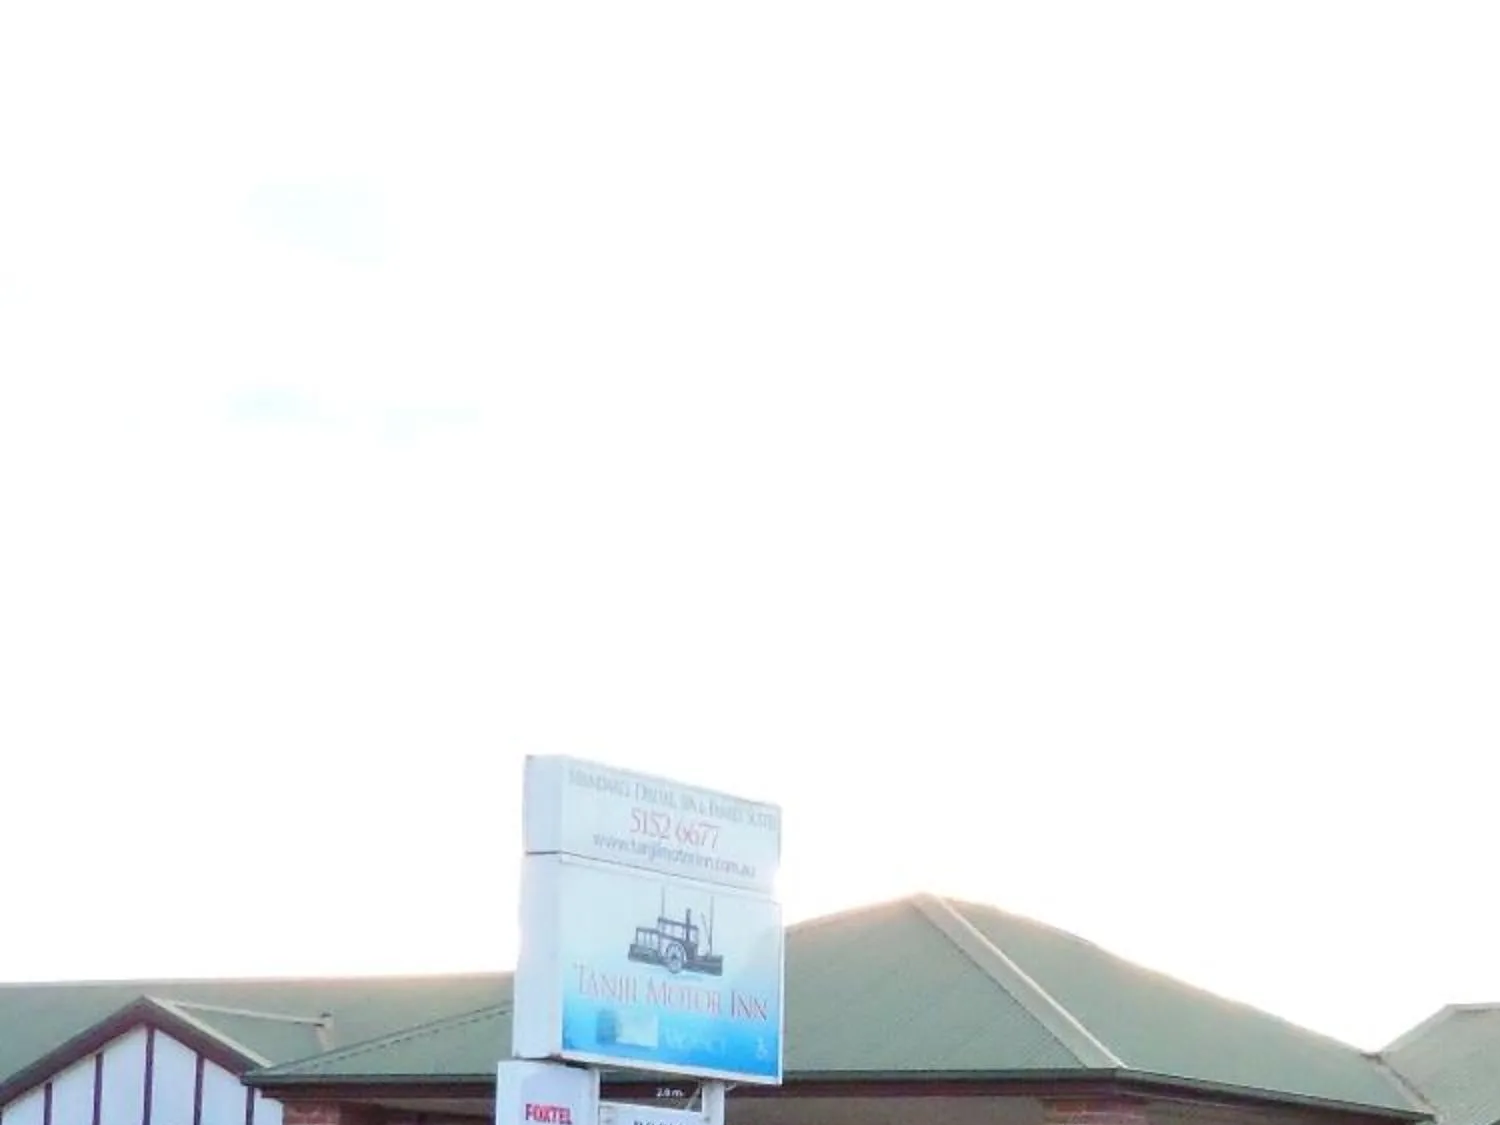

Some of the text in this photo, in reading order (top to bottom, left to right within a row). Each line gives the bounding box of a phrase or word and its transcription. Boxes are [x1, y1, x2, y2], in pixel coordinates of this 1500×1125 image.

[630, 806, 671, 839] 5152
[675, 820, 722, 850] 6677
[647, 975, 722, 1016] MOTOR
[731, 989, 769, 1022] INN
